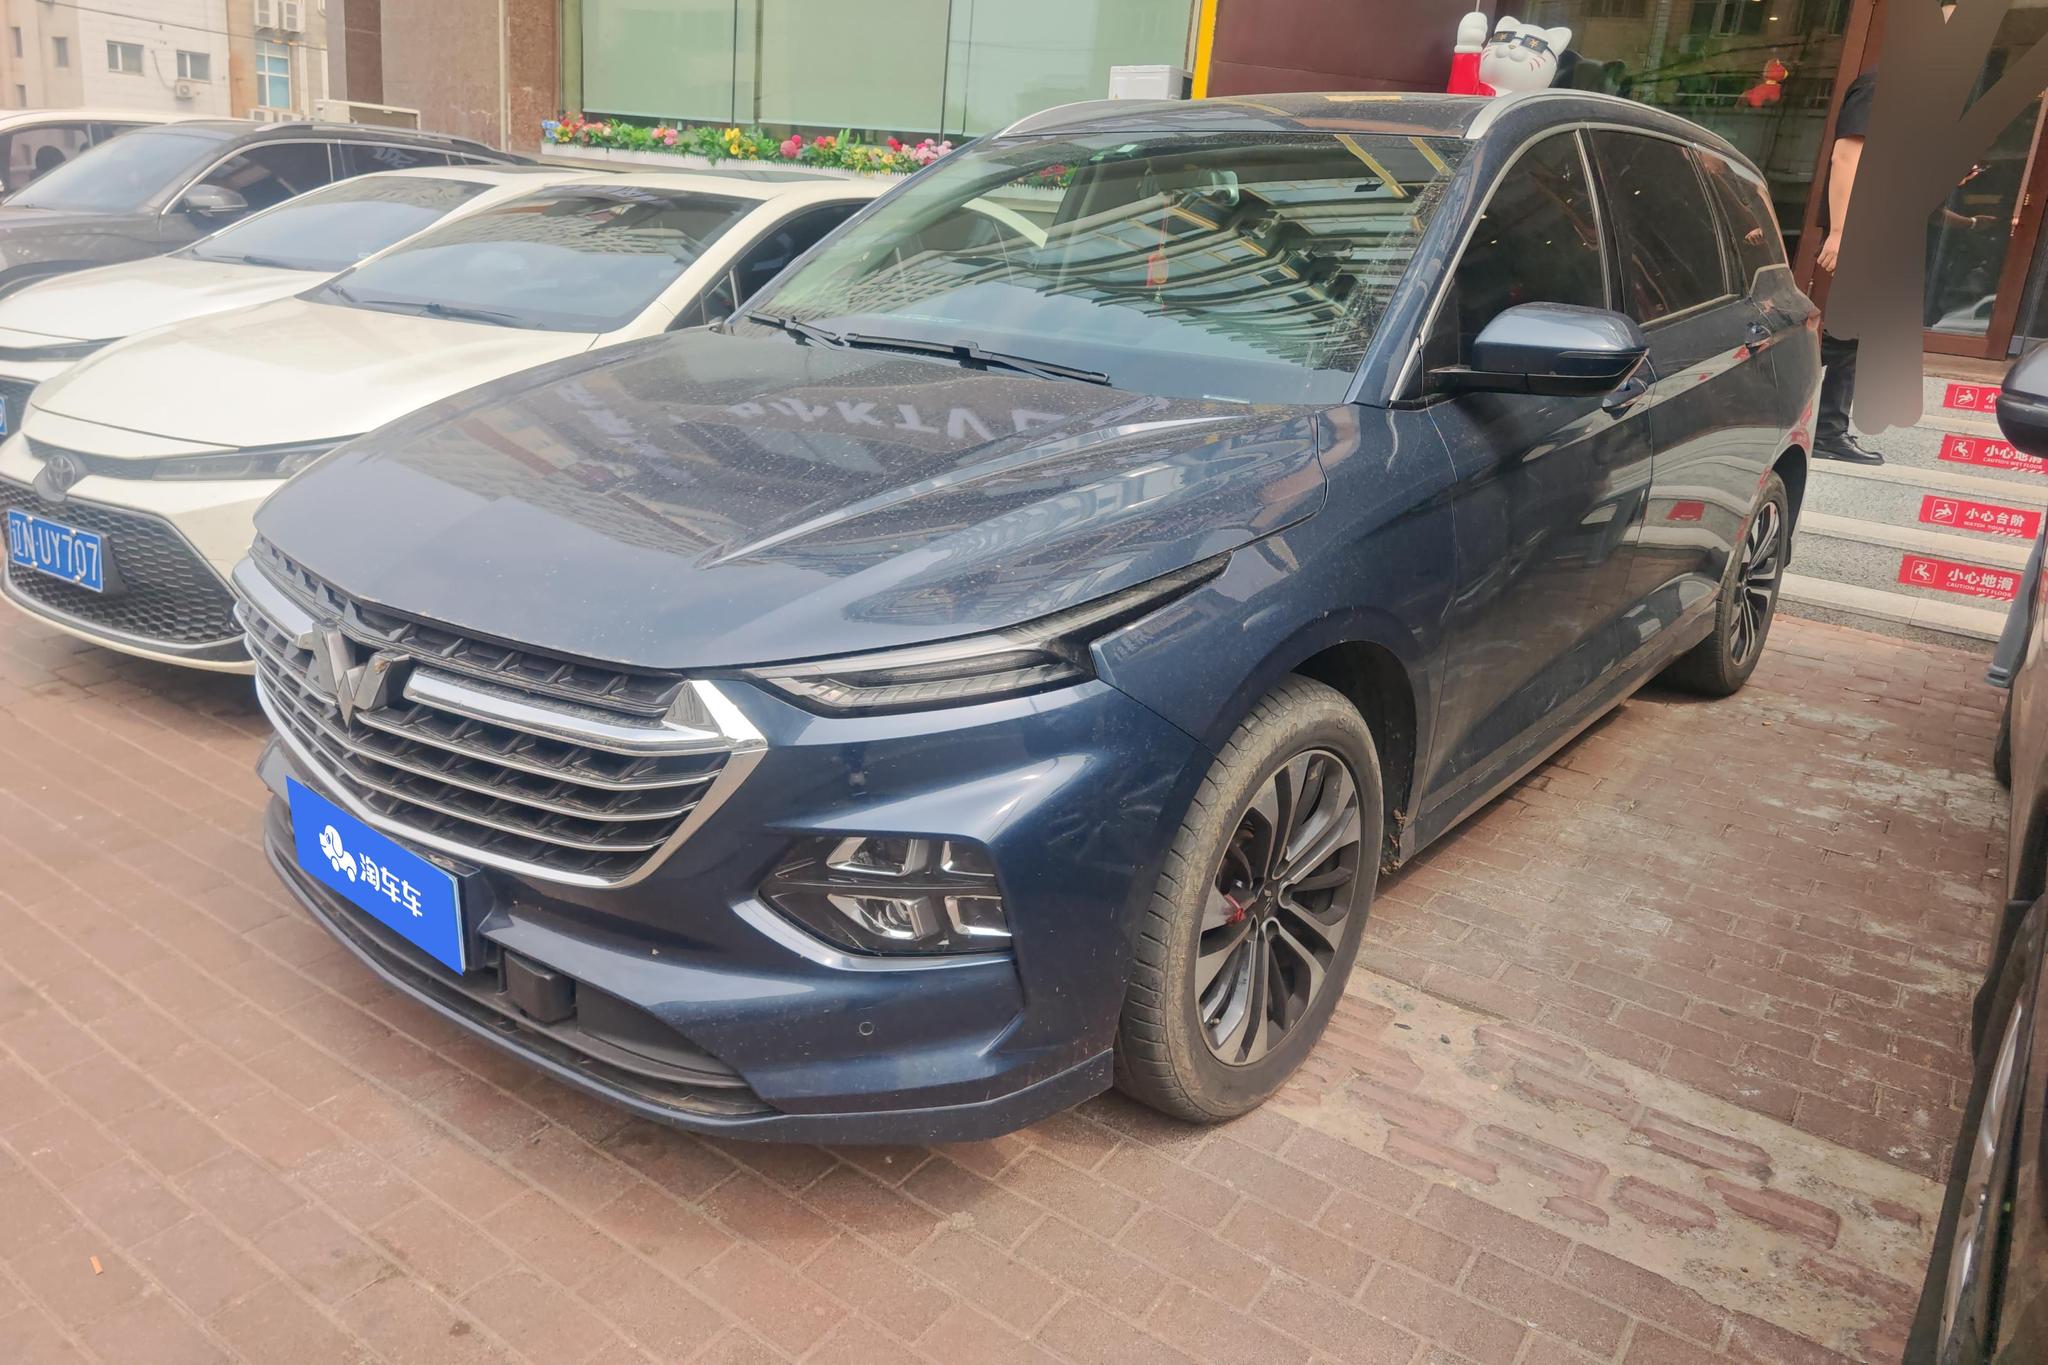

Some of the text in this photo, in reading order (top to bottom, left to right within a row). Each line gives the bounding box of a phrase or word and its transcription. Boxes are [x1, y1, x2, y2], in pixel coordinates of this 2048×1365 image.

[1983, 457, 2009, 465] CAUTION
[1965, 507, 2025, 528] 小心台阶
[1947, 568, 2014, 591] 小心地滑
[1946, 581, 2012, 598] CAUTION WET FLOOR
